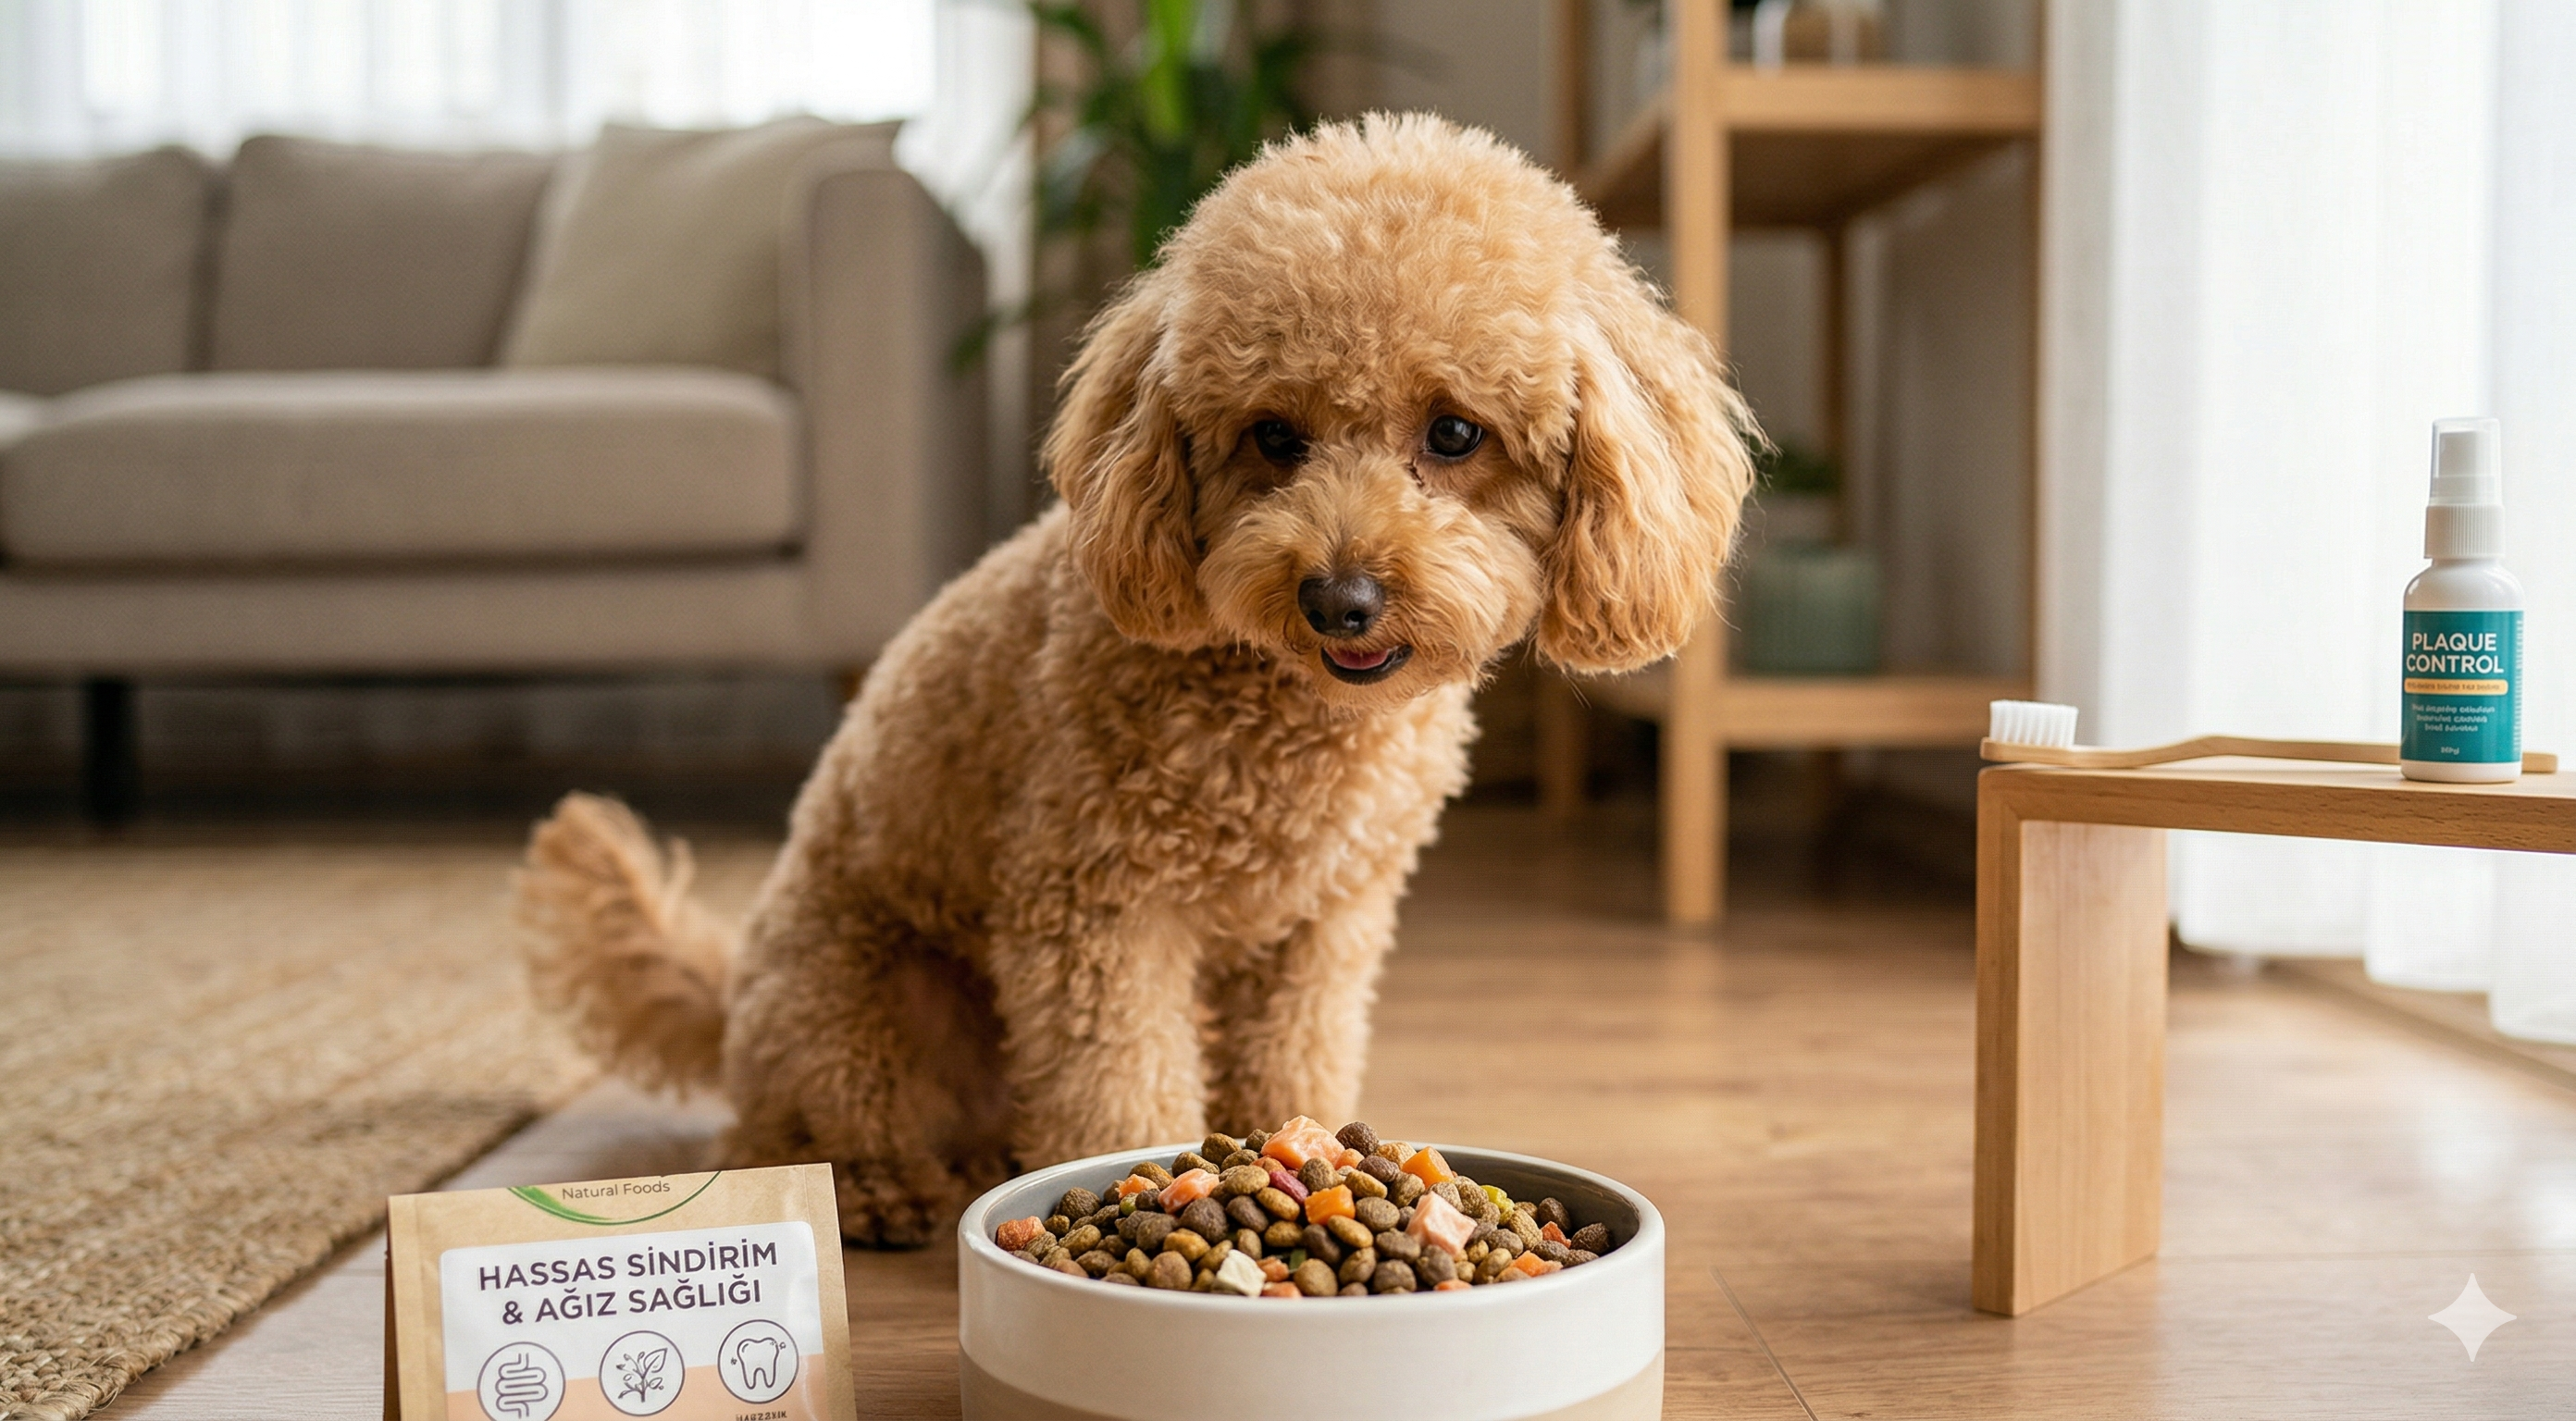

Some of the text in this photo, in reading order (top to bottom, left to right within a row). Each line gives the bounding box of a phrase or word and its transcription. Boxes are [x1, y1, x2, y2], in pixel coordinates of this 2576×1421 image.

[2412, 633, 2497, 651] PLAQUE
[2407, 654, 2505, 673] CONTROL
[562, 1180, 671, 1200] Natural Foods
[479, 1239, 777, 1291] HASSAS SİNDİRİM
[502, 1273, 761, 1325] & AĞIZ SAĞLIĞI
